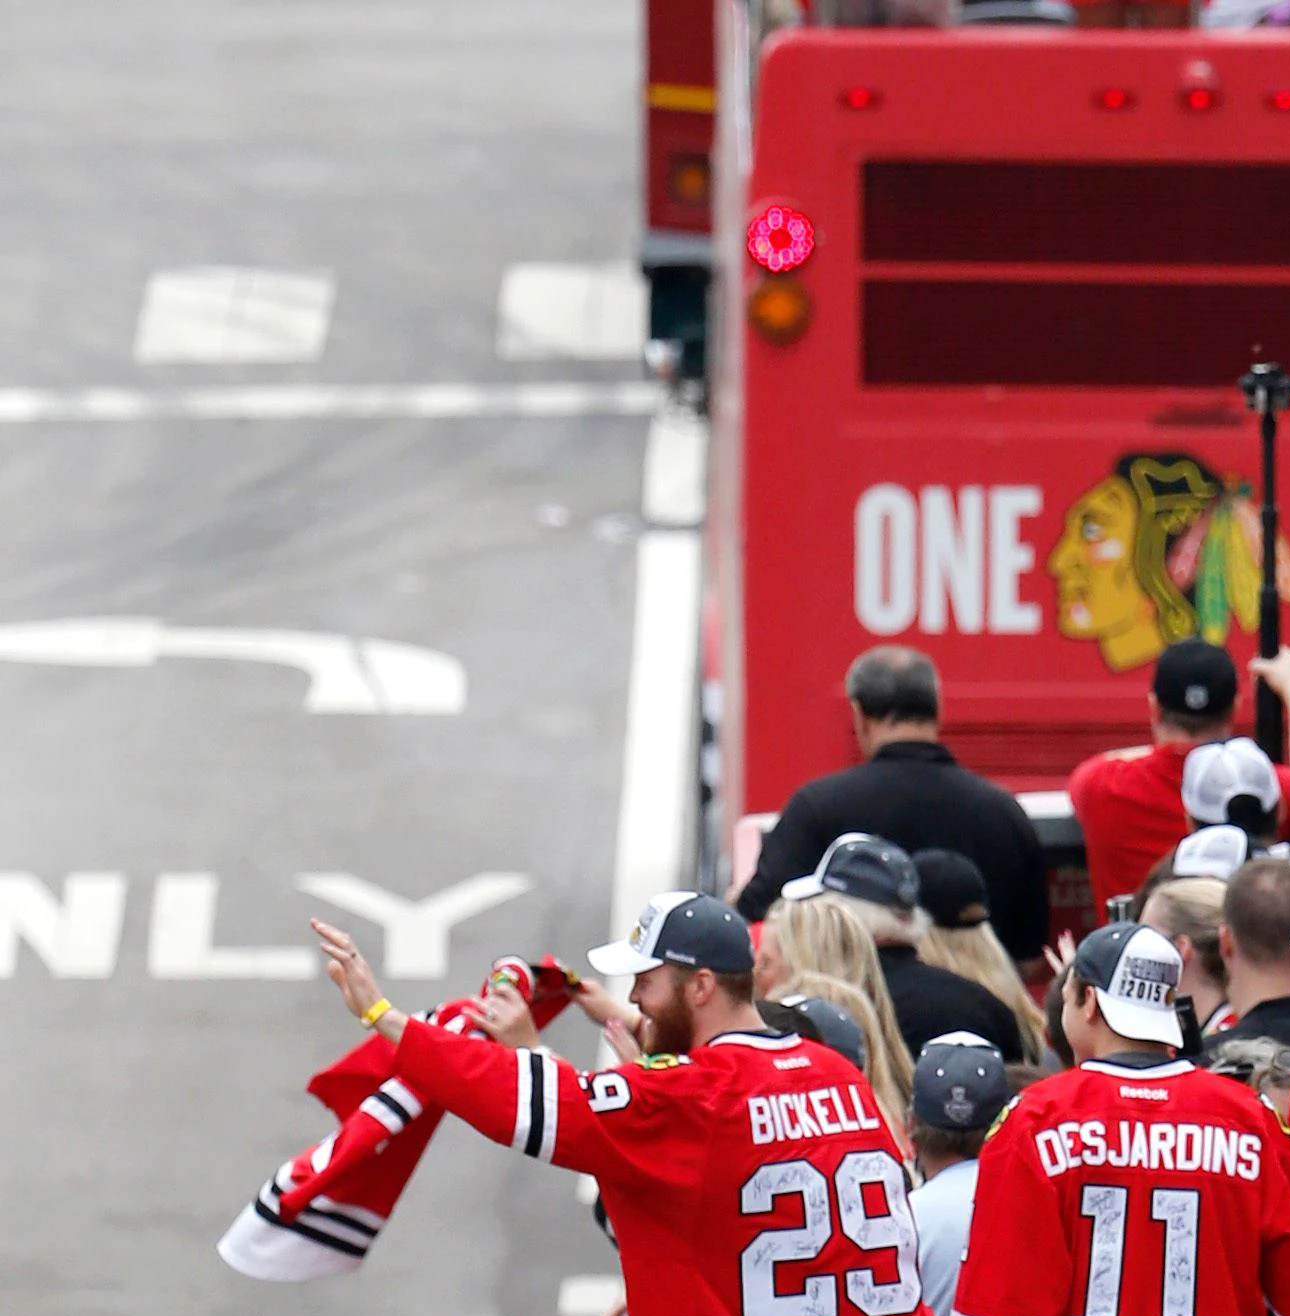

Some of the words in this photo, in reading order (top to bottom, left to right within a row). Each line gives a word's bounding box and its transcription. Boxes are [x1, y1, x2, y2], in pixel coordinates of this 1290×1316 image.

[853, 483, 1044, 637] ONE
[1126, 980, 1162, 1003] 2015
[748, 1084, 880, 1145] BICKELL
[1119, 1085, 1169, 1101] Reebok
[1035, 1120, 1262, 1181] DESJARDINS
